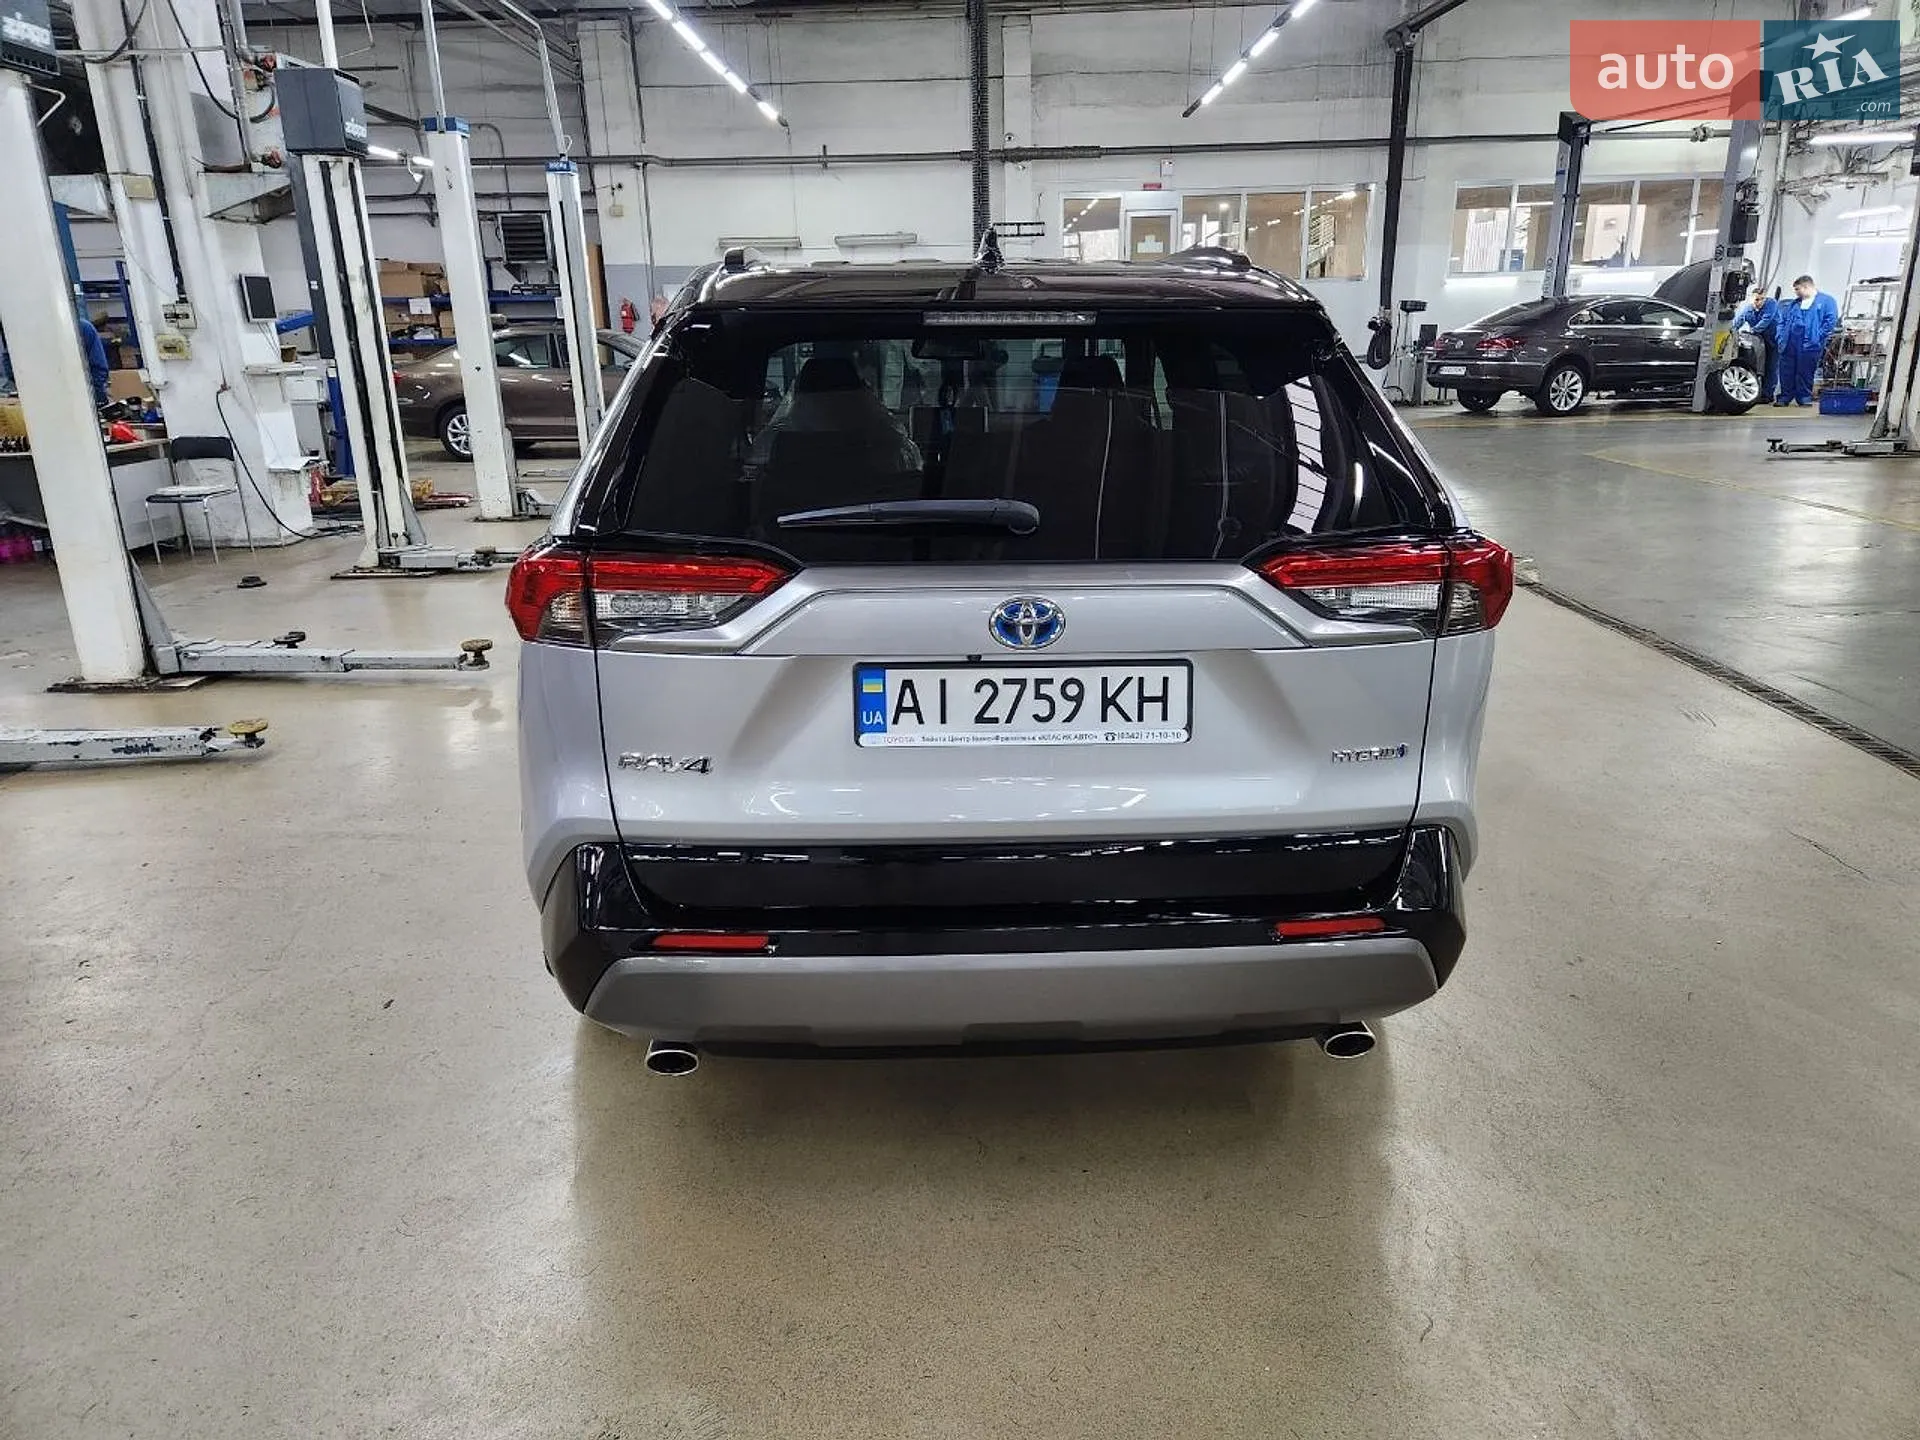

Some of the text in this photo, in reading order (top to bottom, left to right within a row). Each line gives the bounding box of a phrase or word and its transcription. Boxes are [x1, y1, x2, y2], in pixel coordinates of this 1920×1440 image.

[892, 676, 1169, 725] AI 2759 KH
[862, 711, 884, 725] UA
[617, 752, 711, 774] RAV4
